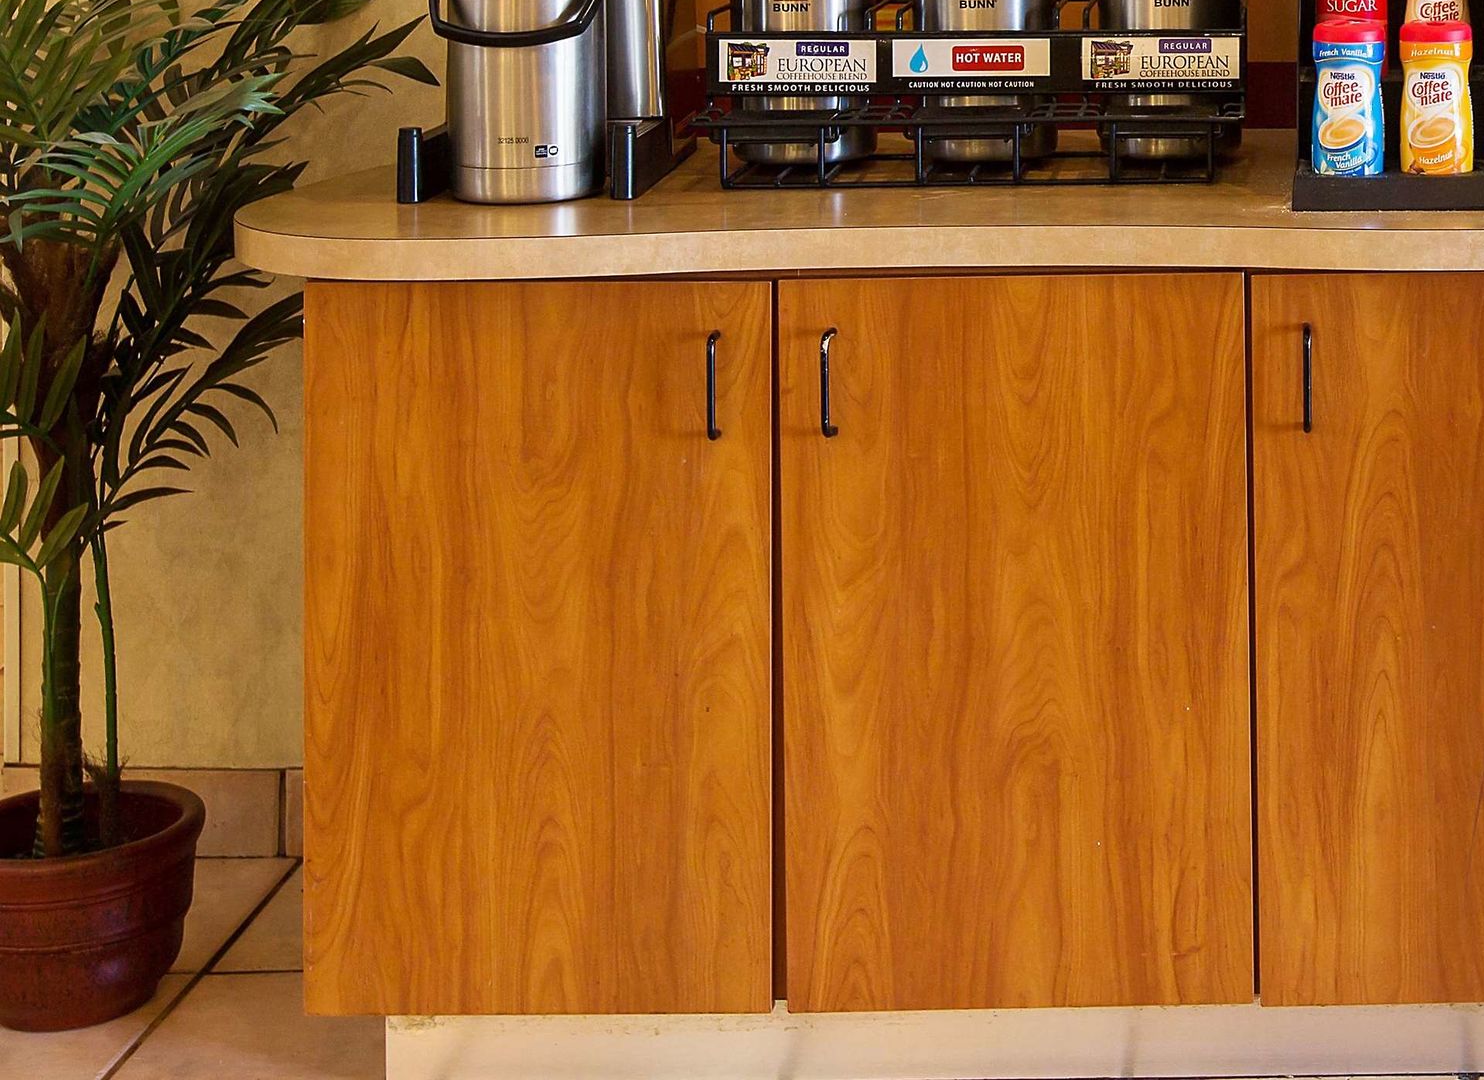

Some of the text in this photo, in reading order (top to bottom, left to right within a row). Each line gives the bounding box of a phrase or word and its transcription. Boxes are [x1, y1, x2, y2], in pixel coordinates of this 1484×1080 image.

[772, 3, 809, 12] BUNN
[959, 0, 995, 9] BUNN
[800, 45, 845, 53] REGULAR
[1163, 42, 1208, 50] REGULAR
[1319, 48, 1339, 57] French
[1411, 47, 1454, 57] Hazelnut
[955, 52, 1022, 63] HOT WATER
[1141, 55, 1229, 69] EUROPEAN
[777, 58, 867, 72] EUROPEAN
[776, 72, 867, 81] COFFEEHOUSE BLEND
[1139, 69, 1230, 78] COFFEEHOUSE BLEND
[731, 84, 870, 92] FRESH SMOOTH DELICIOUS
[908, 81, 938, 89] CAUTION
[1095, 81, 1127, 89] FRESH
[1330, 93, 1362, 107] mate
[1327, 152, 1351, 162] French
[1418, 150, 1454, 165] Hazelnut
[1335, 155, 1363, 169] Vanilla
